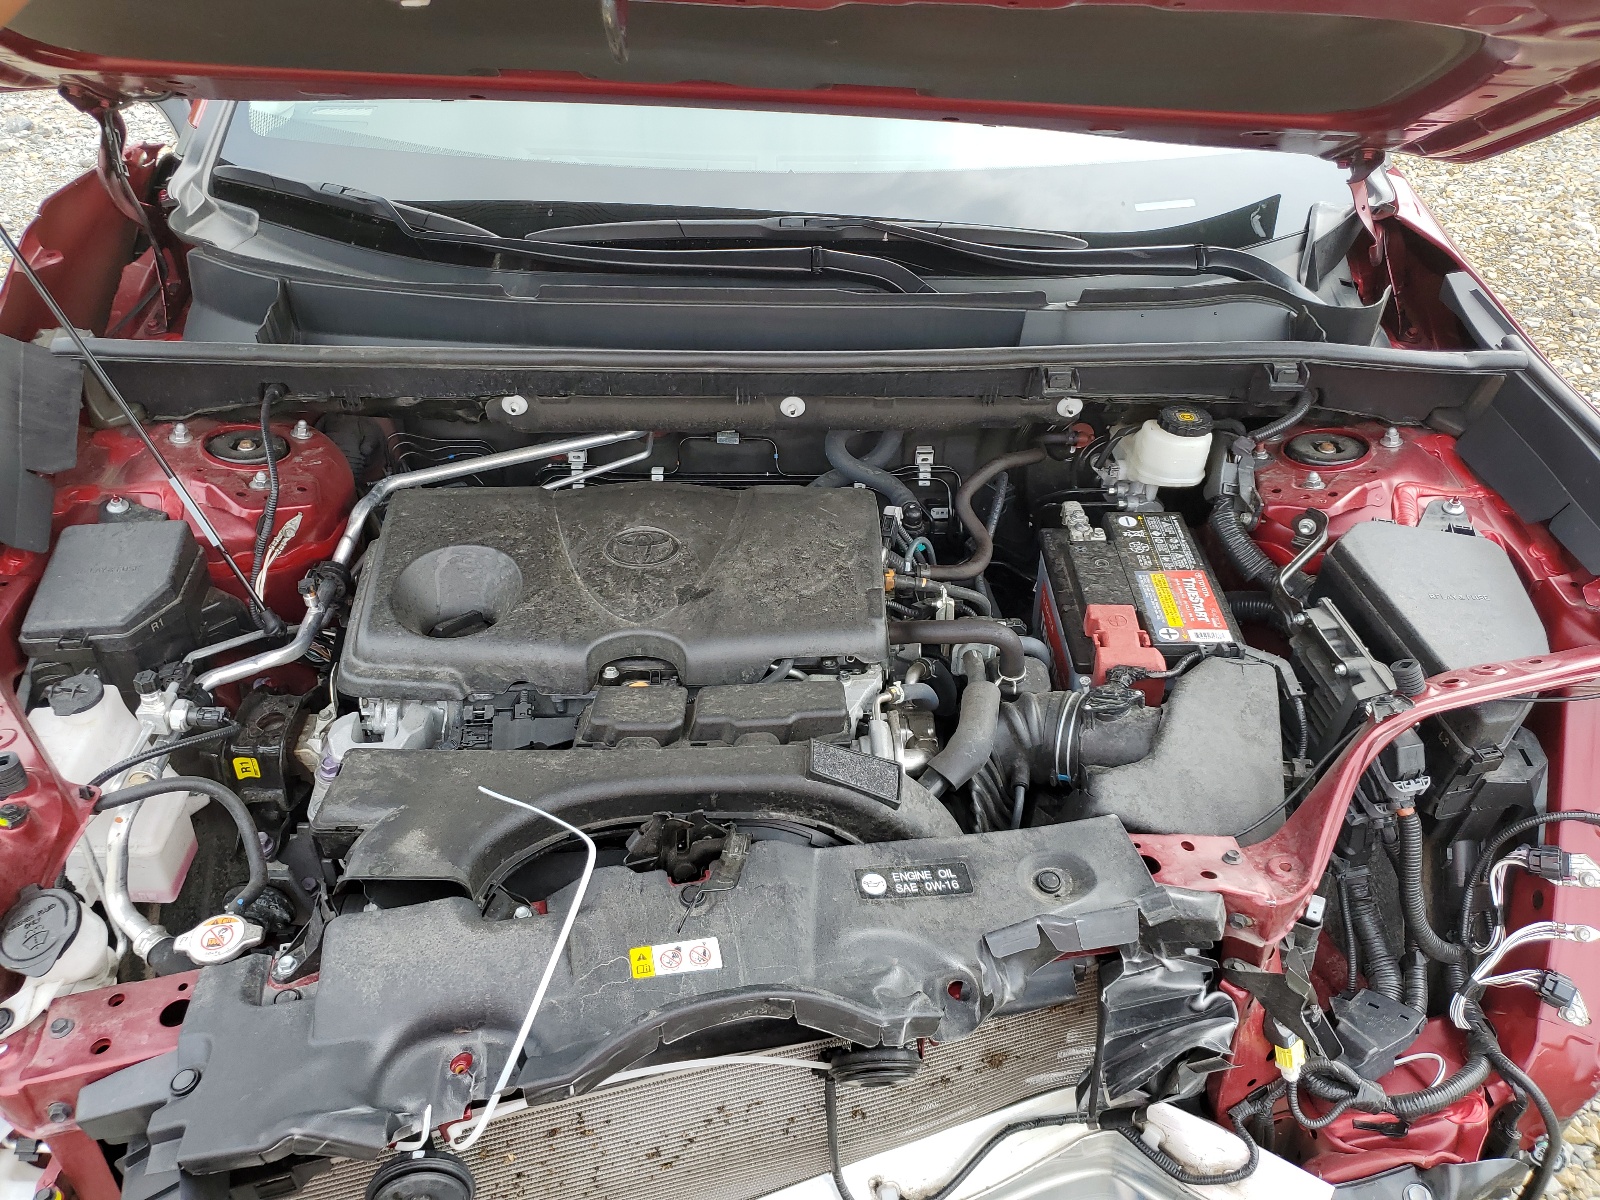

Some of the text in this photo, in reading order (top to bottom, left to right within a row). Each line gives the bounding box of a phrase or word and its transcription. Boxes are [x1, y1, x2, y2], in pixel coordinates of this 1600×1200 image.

[150, 617, 164, 633] R1
[238, 761, 252, 774] R1
[892, 868, 958, 882] ENGINE OIL
[895, 880, 960, 894] SAE 0W-16
